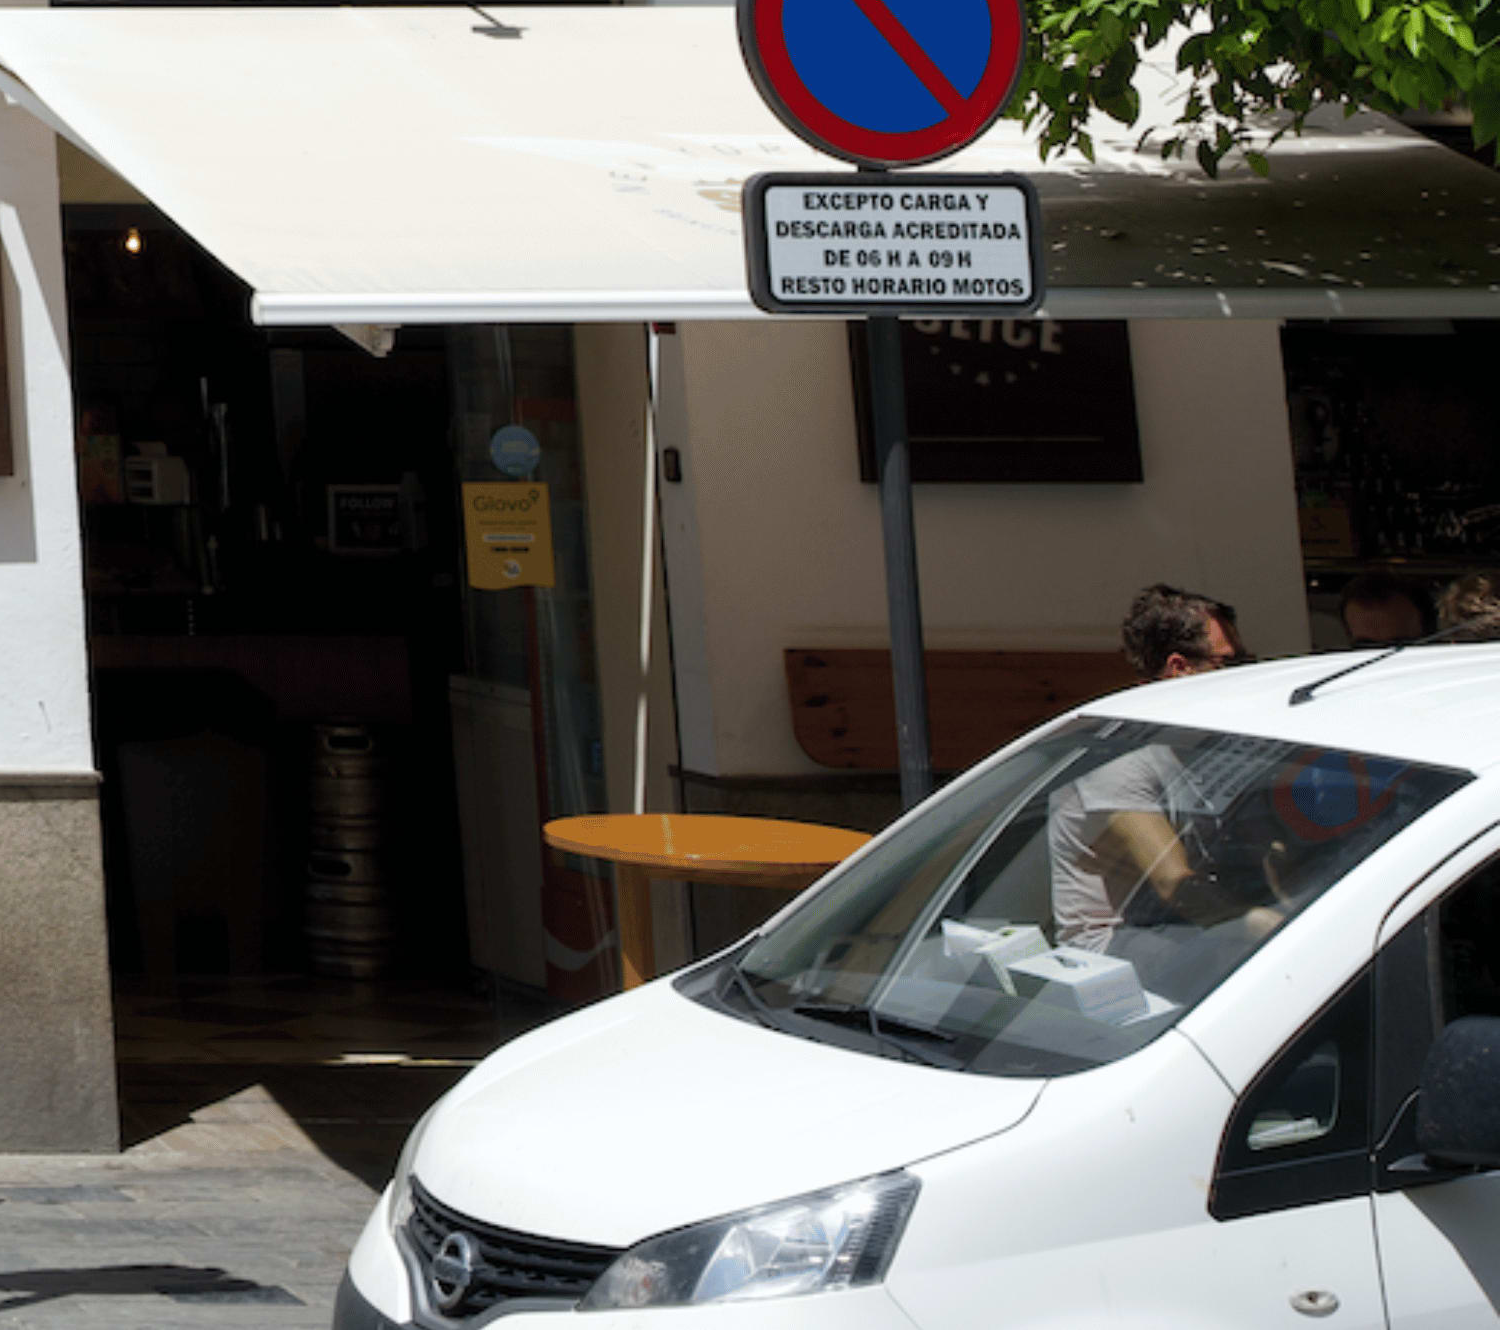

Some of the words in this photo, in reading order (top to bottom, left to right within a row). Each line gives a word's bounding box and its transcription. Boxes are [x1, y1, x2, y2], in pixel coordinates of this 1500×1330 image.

[803, 192, 895, 211] EXCEPTO
[899, 192, 971, 211] CARGA
[976, 192, 990, 211] Y
[776, 221, 888, 240] DESCARGA
[892, 220, 1023, 240] ACREDITADA
[823, 249, 851, 268] DE
[856, 249, 883, 268] 06
[887, 249, 903, 268] H
[907, 249, 921, 268] A
[929, 249, 956, 268] 09
[958, 249, 972, 268] H
[781, 277, 846, 296] RESTO
[852, 277, 947, 296] HORARIO
[952, 277, 1025, 296] MOTOS
[474, 494, 532, 512] Glovo
